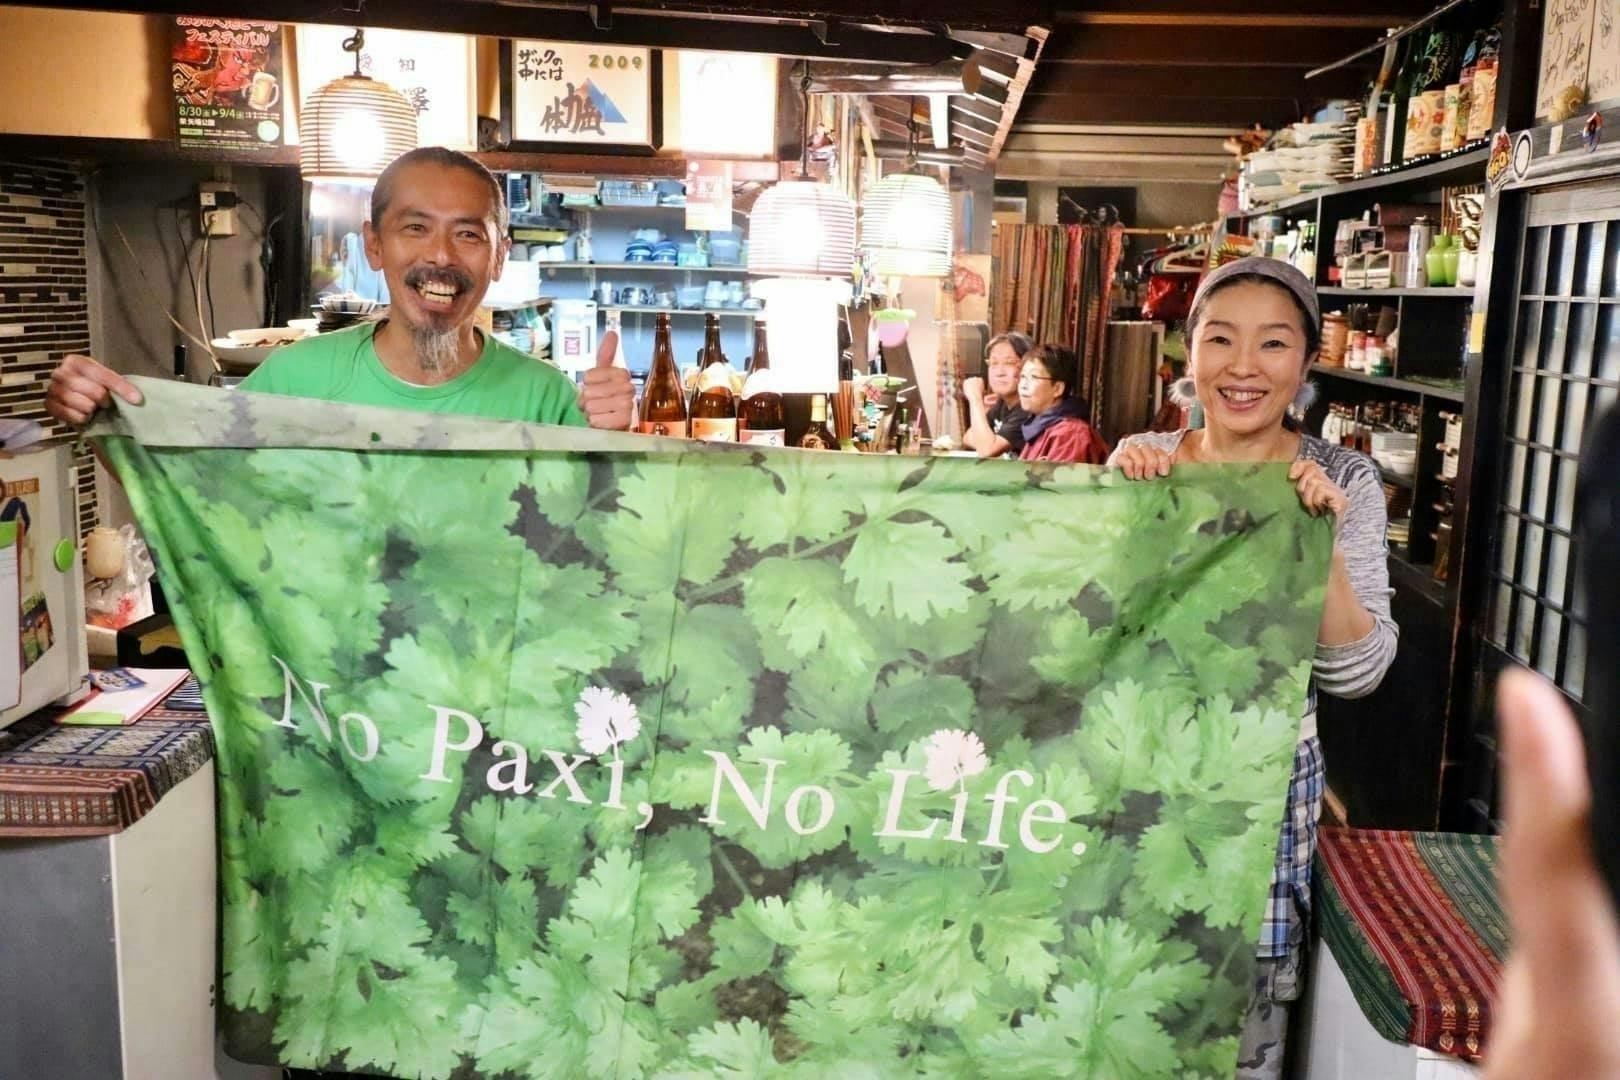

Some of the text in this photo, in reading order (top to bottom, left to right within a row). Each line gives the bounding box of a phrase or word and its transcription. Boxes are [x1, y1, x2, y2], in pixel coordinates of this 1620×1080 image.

[518, 49, 563, 66] ザックの
[588, 54, 643, 69] 2009
[518, 64, 564, 82] 中には
[179, 106, 202, 117] 8/30
[219, 108, 236, 119] 9/4
[271, 654, 1088, 856] No Paxi, No Life.
